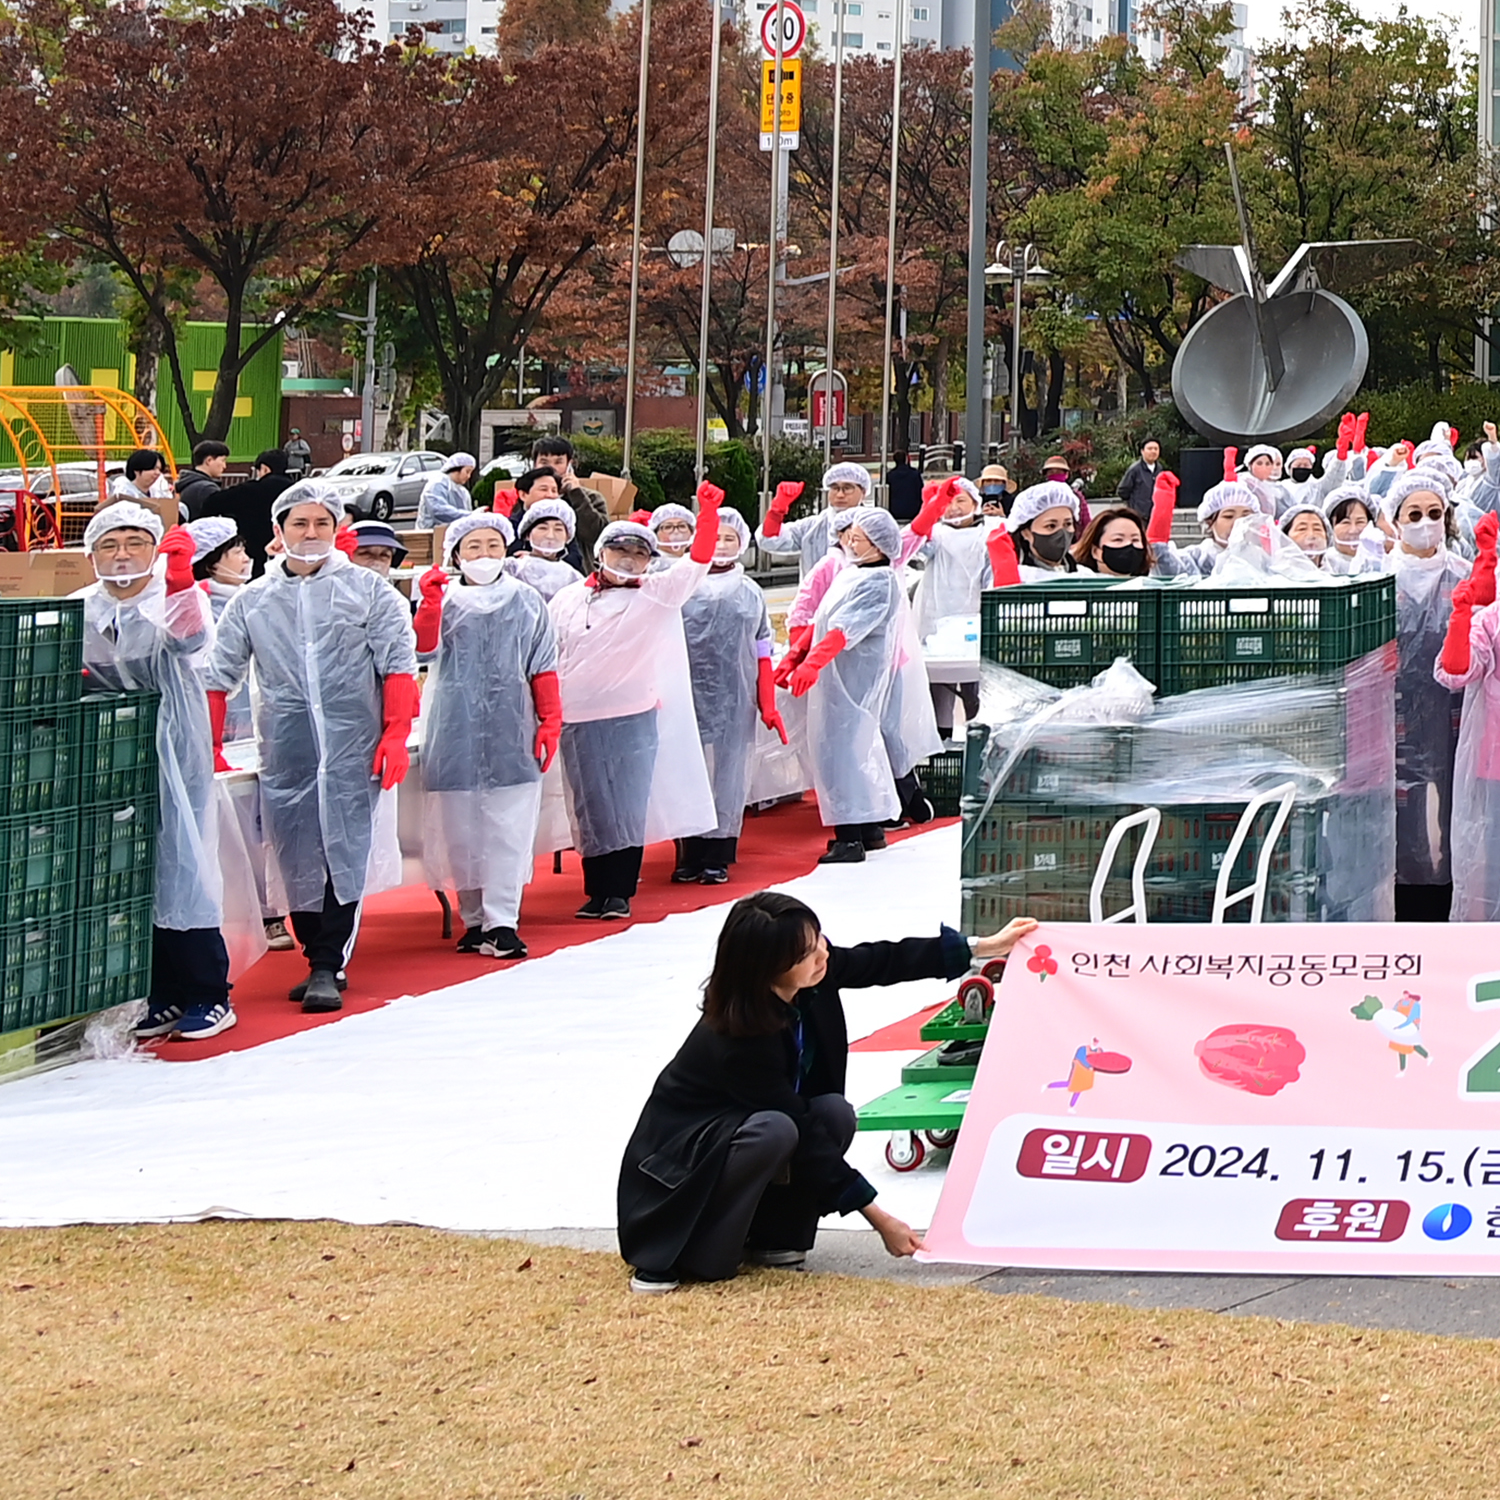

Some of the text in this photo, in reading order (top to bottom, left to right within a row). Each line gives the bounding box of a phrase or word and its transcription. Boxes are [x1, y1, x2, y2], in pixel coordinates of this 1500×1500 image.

[1070, 951, 1422, 987] 인천 사회복지공동모금회
[1041, 1133, 1131, 1179] 일시
[1158, 1143, 1280, 1182] 2024.
[1308, 1148, 1368, 1184] 11.
[1293, 1200, 1390, 1239] 후원
